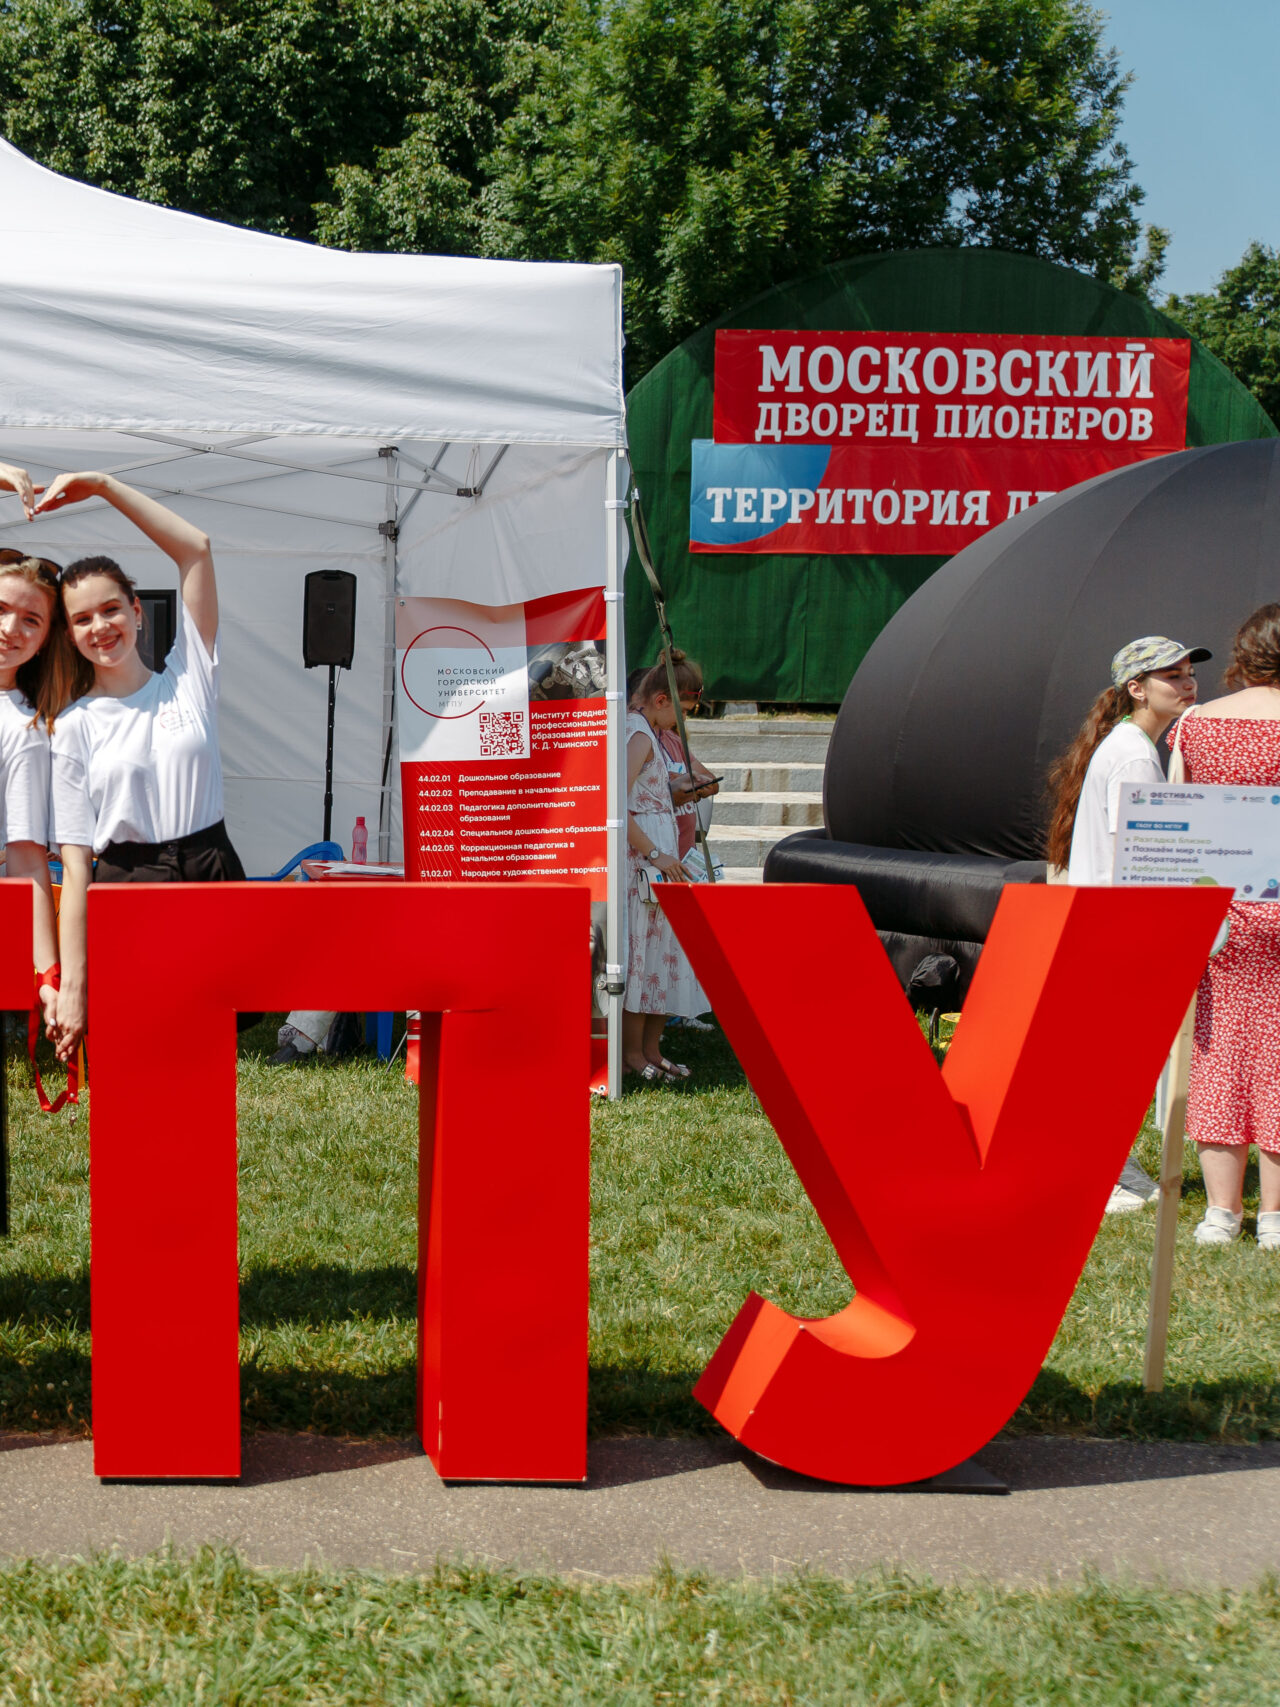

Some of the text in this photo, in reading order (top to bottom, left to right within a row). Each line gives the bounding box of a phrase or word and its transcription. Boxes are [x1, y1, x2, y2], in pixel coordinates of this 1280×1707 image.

[758, 343, 1155, 398] МОСКОВСКИЙ
[755, 402, 1154, 443] ДВОРЕЦ ПИОНЕРОВ
[706, 487, 990, 525] ТЕРРИТОРИЯ
[437, 666, 505, 675] МОСКОВСКИЙ
[438, 678, 496, 686] ГОРОДСКОЙ
[438, 688, 506, 697] УНИВЕРСИТЕТ
[531, 711, 570, 720] Институт
[532, 730, 586, 740] образования
[532, 740, 598, 750] К. Д. Ушинского
[418, 772, 561, 783] 44.02.01 Дошкольное образование
[419, 789, 453, 797] 44.02.02
[459, 789, 516, 798] Преподавание
[525, 786, 567, 794] начальных
[569, 784, 600, 792] классах
[1150, 792, 1205, 800] ФЕСТИВАЛЬ
[419, 801, 576, 812] 44.02.03 Педагогика дополнительного
[459, 814, 511, 823] образования
[420, 829, 454, 837] 44.02.04
[460, 829, 513, 838] Специальное
[515, 827, 563, 836] дошкольное
[1132, 836, 1212, 845] Разгадка близко
[420, 844, 455, 852] 44.02.05
[460, 843, 522, 852] Коррекционная
[524, 841, 568, 850] педагогика
[1132, 845, 1173, 853] Познаём
[1205, 848, 1253, 856] цифровой
[505, 853, 557, 862] образовании
[1131, 855, 1199, 864] лабораторией
[421, 869, 452, 877] 51.02.01
[461, 869, 501, 878] Народное
[502, 867, 568, 877] художественное
[1131, 865, 1179, 873] Арбузный
[1130, 874, 1165, 882] Играем
